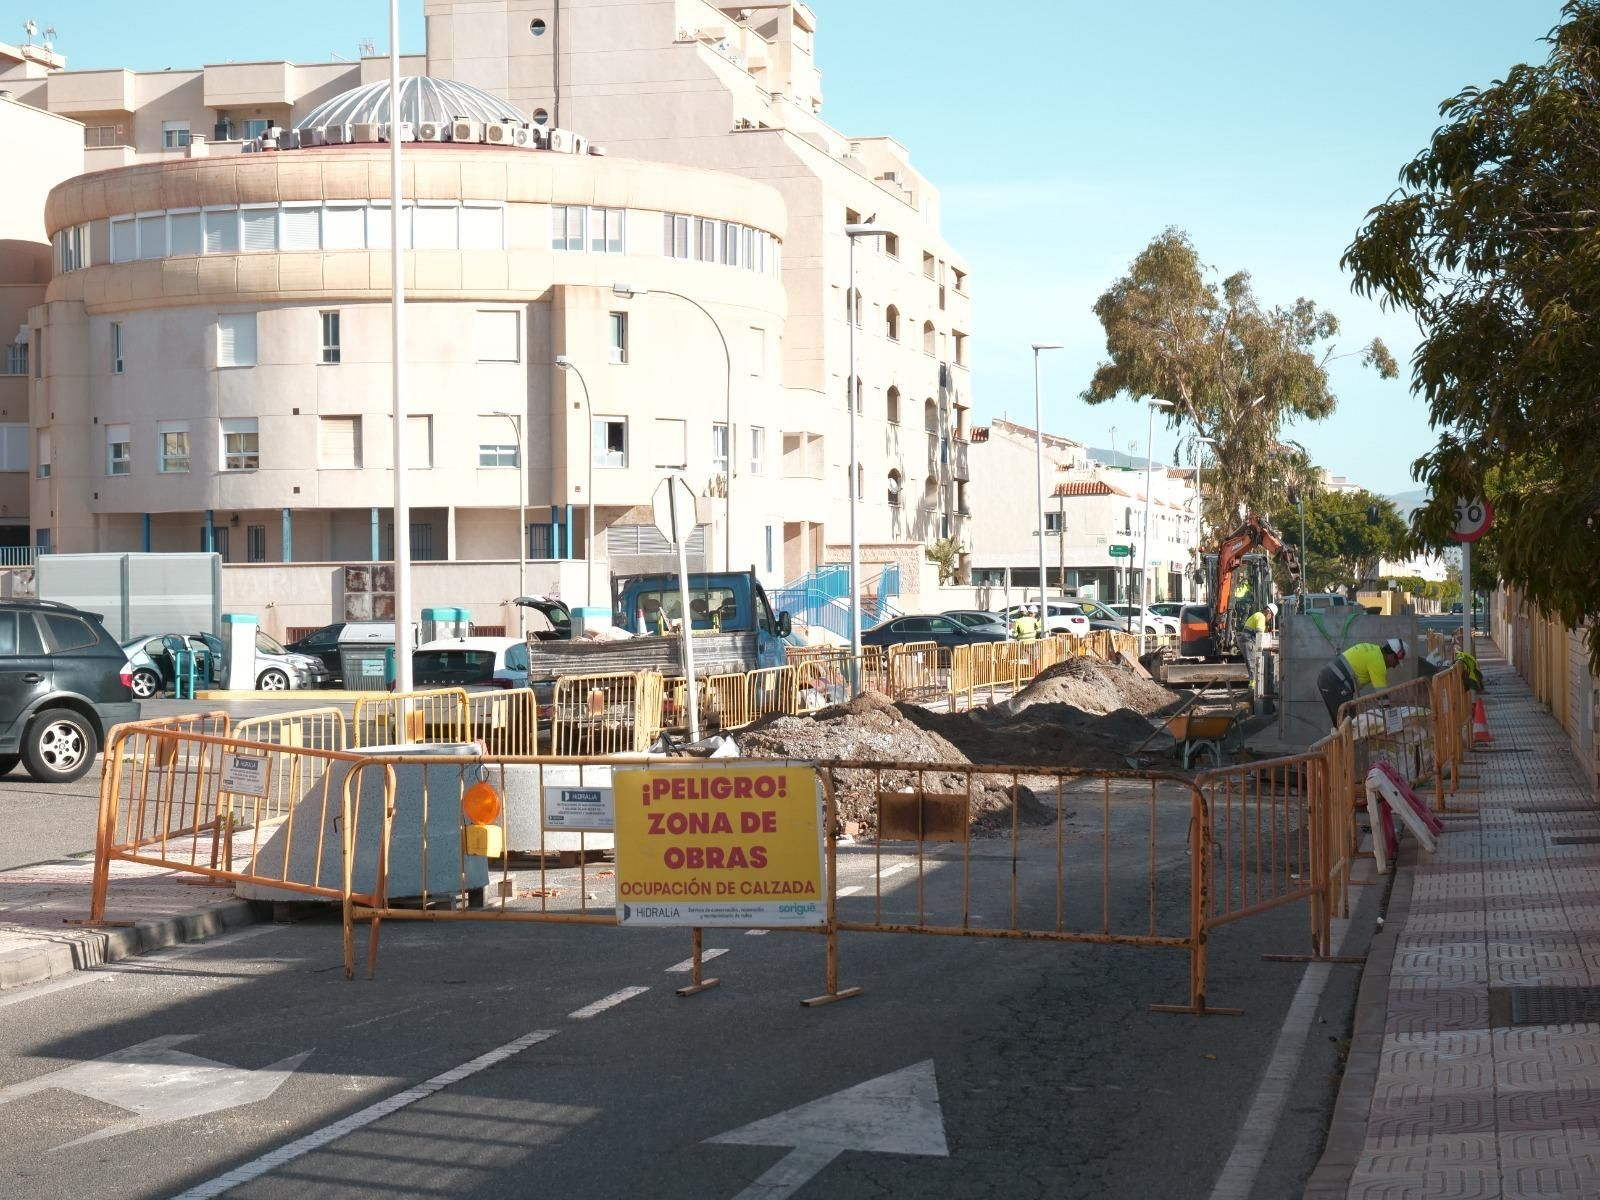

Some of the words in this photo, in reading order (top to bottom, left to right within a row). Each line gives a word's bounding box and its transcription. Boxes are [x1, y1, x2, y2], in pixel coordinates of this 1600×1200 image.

[642, 775, 787, 806] ¡PELIGRO!
[647, 812, 733, 835] ZONA
[740, 811, 777, 833] DE
[663, 846, 768, 869] OBRAS
[620, 878, 712, 896] OCUPACIÓN
[716, 881, 736, 895] DE
[740, 880, 816, 895] CALZADA
